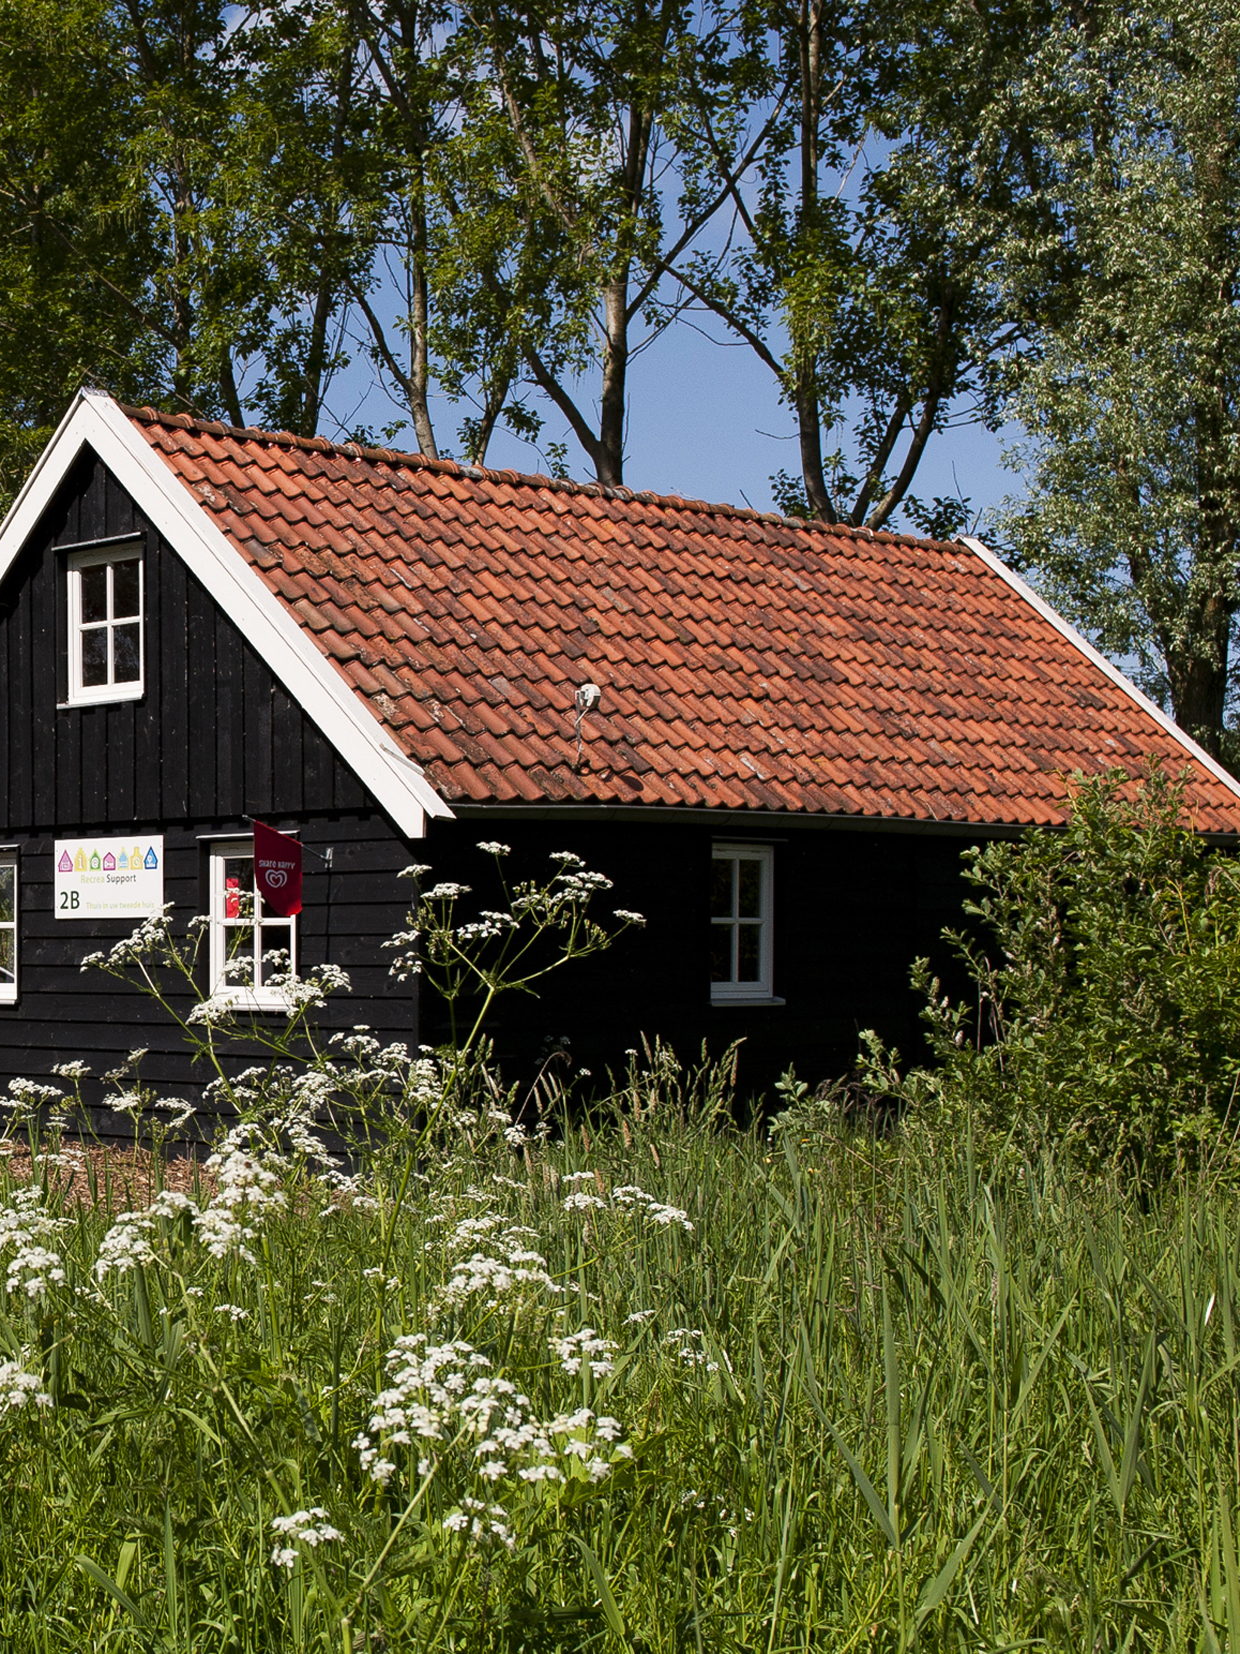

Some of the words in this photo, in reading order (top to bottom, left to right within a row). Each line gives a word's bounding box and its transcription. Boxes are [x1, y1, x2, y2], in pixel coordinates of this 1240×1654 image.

[80, 874, 105, 884] Recrea
[106, 874, 137, 885] Support
[60, 890, 80, 910] 2B
